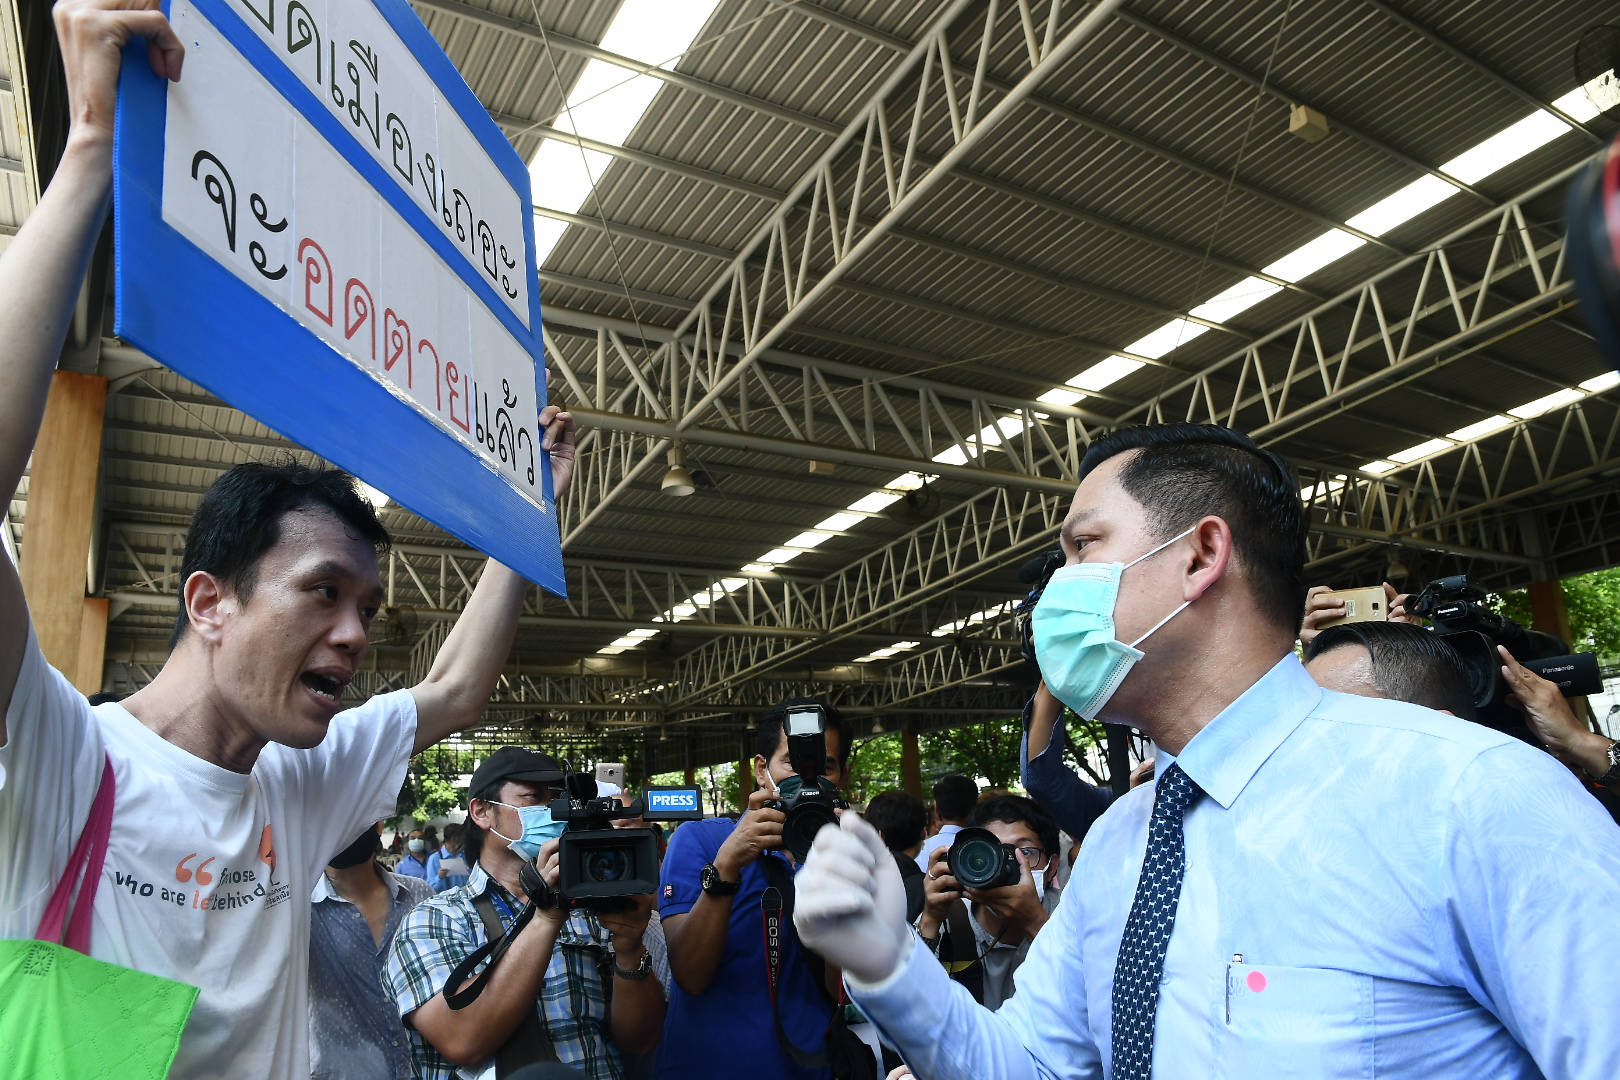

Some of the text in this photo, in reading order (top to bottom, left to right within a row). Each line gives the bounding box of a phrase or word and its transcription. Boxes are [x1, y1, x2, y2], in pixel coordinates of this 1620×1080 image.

[1542, 664, 1575, 674] Panasonic
[652, 795, 694, 806] PRESS
[161, 887, 186, 906] are
[768, 917, 778, 947] EOS
